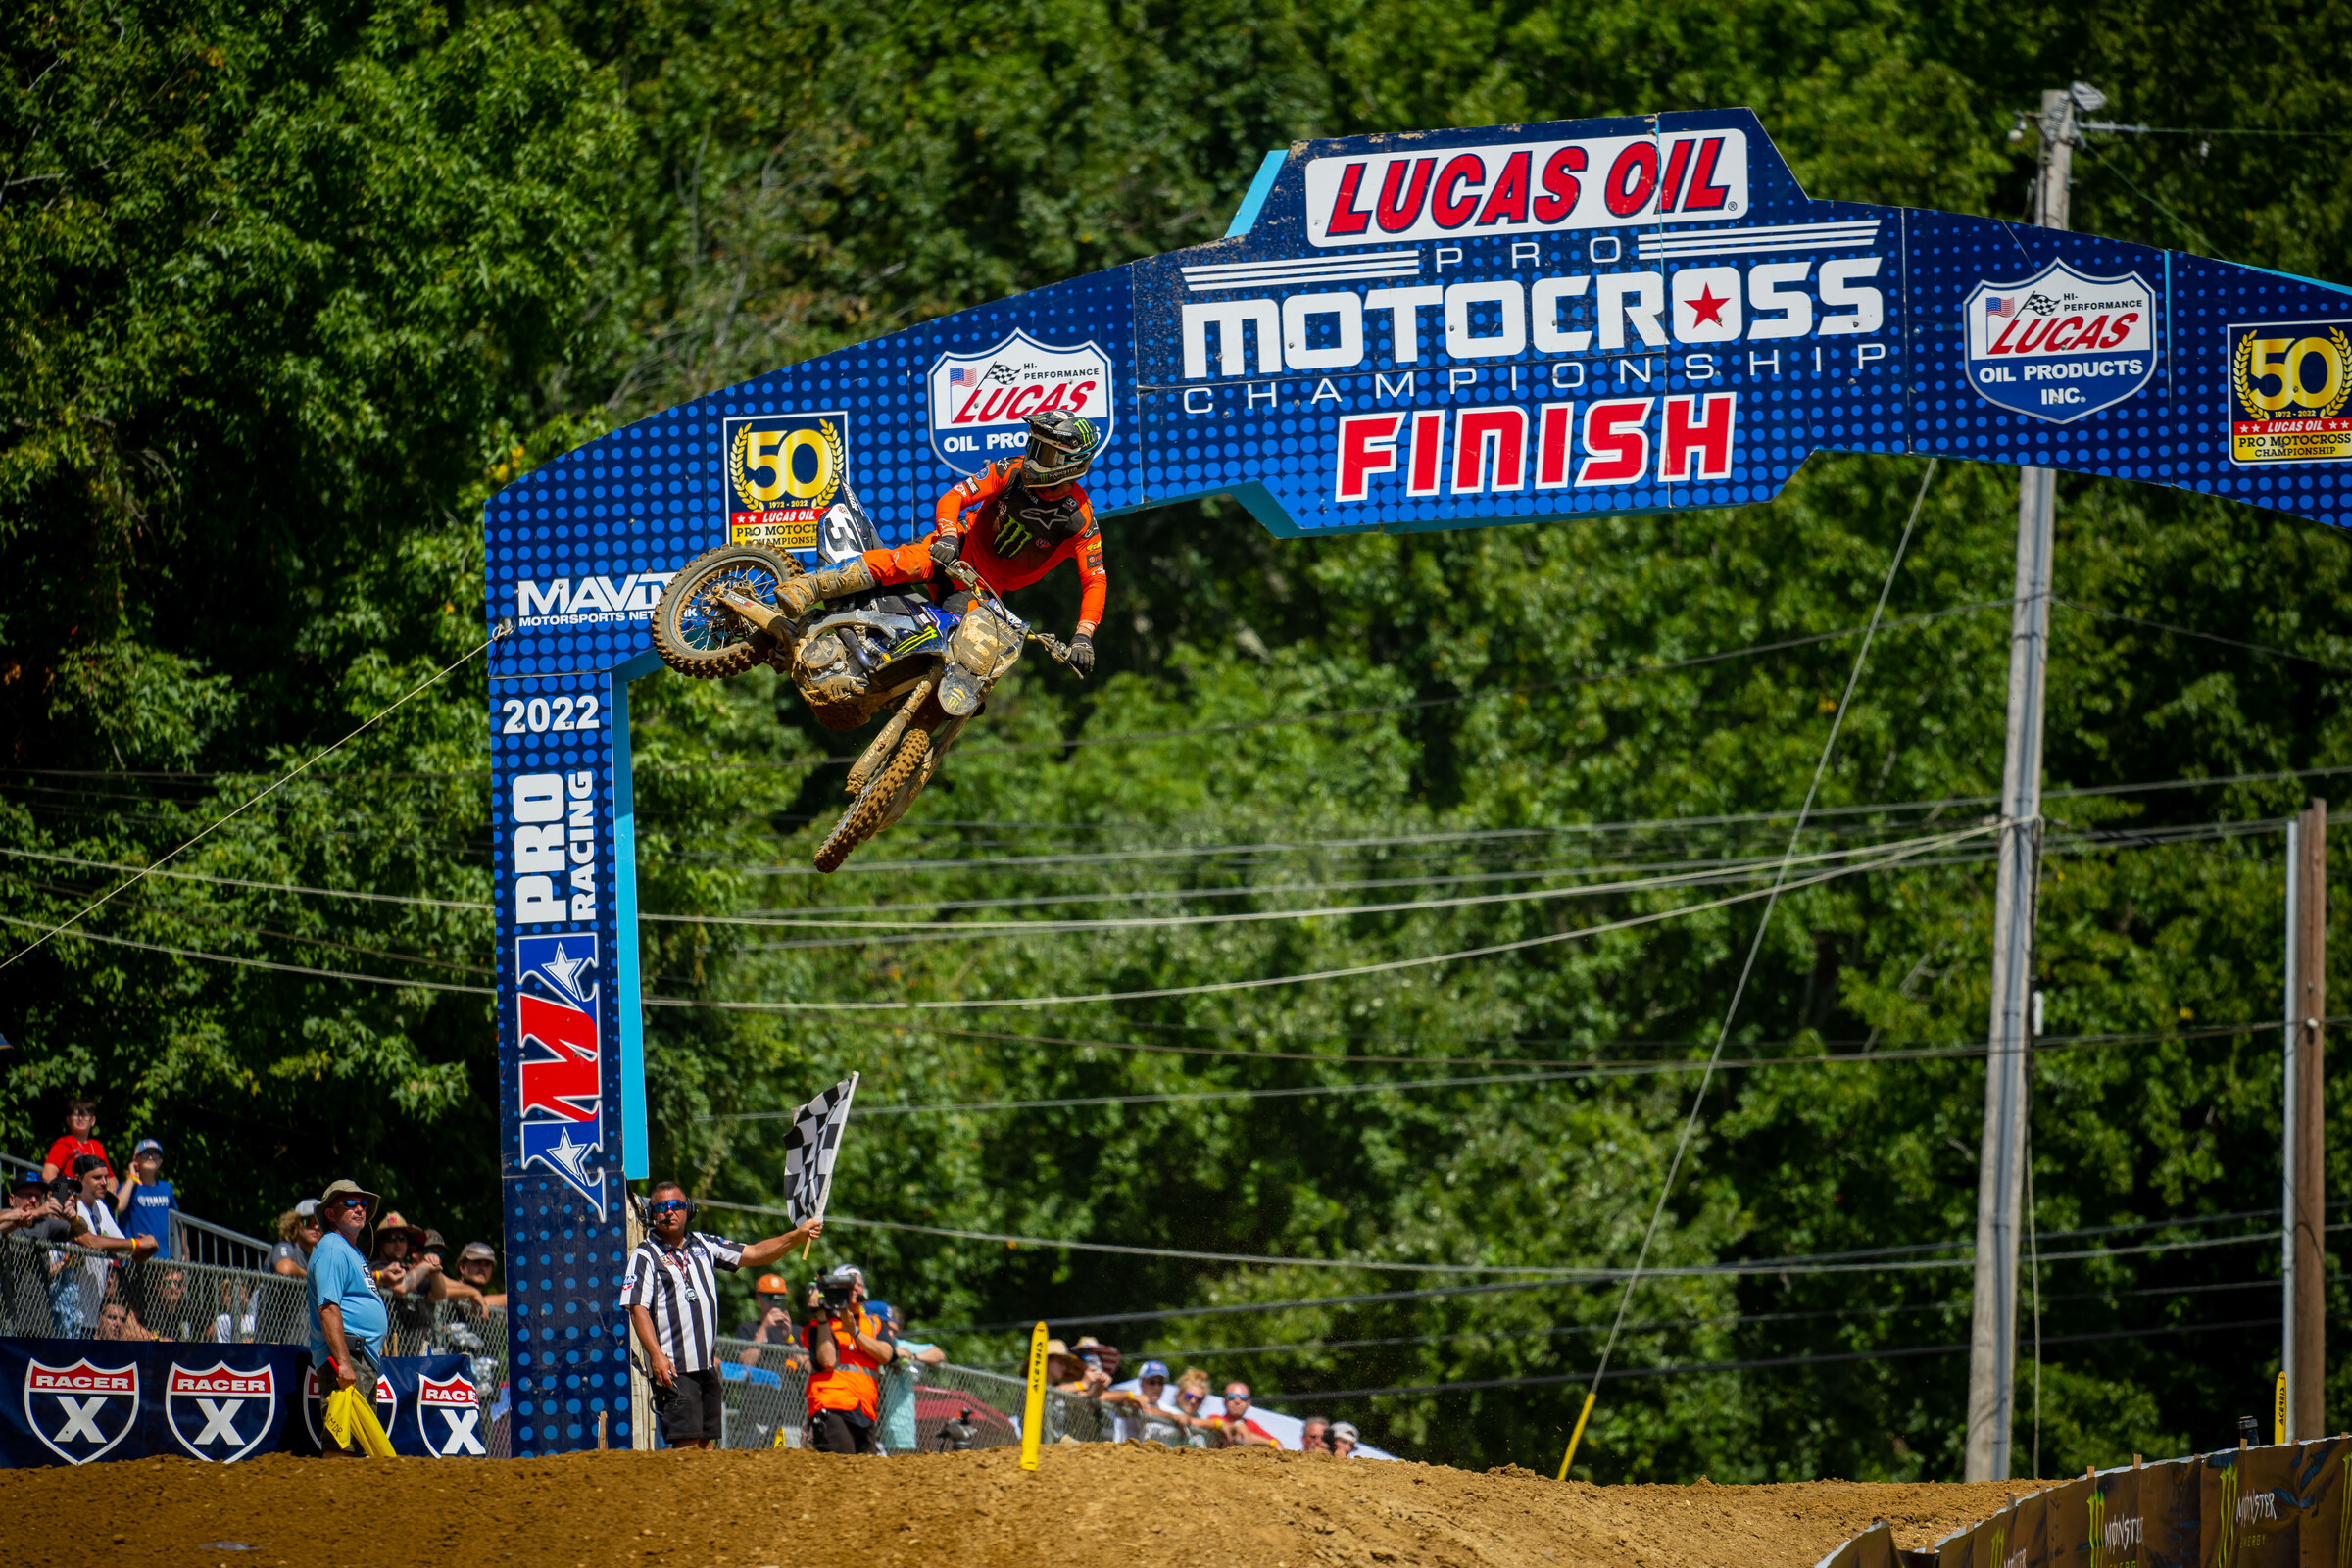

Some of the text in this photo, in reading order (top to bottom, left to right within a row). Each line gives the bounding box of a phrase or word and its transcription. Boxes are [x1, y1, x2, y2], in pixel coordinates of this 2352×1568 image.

[1326, 137, 1731, 237] LUCAS OIL
[1435, 235, 1622, 273] PRO
[2063, 292, 2079, 301] HI-
[2064, 299, 2143, 312] PERFORMANCE
[1181, 257, 1884, 379] MOTOCROSS
[1987, 313, 2139, 355] LUCAS
[1023, 368, 1100, 381] PERFORMANCE
[1183, 343, 1886, 415] CHAMPIONSHIP
[1979, 359, 2143, 383] OIL PRODUCTS
[2248, 336, 2344, 411] 50
[952, 380, 1097, 424] LUCAS
[943, 435, 980, 453] OIL
[2238, 433, 2352, 447] PRO MOTOCROSS
[2267, 419, 2323, 433] LUCAS OIL
[745, 428, 834, 502] 50
[1335, 392, 1737, 503] FINISH
[2254, 446, 2336, 458] CHAMPIONSHIP
[736, 526, 761, 537] PRO
[762, 510, 815, 523] LUCAS OIL
[822, 517, 860, 553] 3
[519, 611, 626, 627] MOTORSPORTS
[503, 696, 600, 735] 2022
[512, 772, 567, 924] PRO
[568, 770, 596, 921] RACING
[35, 1375, 129, 1390] RACER
[176, 1379, 266, 1392] RACER
[52, 1396, 109, 1444] X
[193, 1398, 246, 1446] X
[439, 1409, 487, 1455] X
[2235, 1488, 2278, 1529] MONSTER
